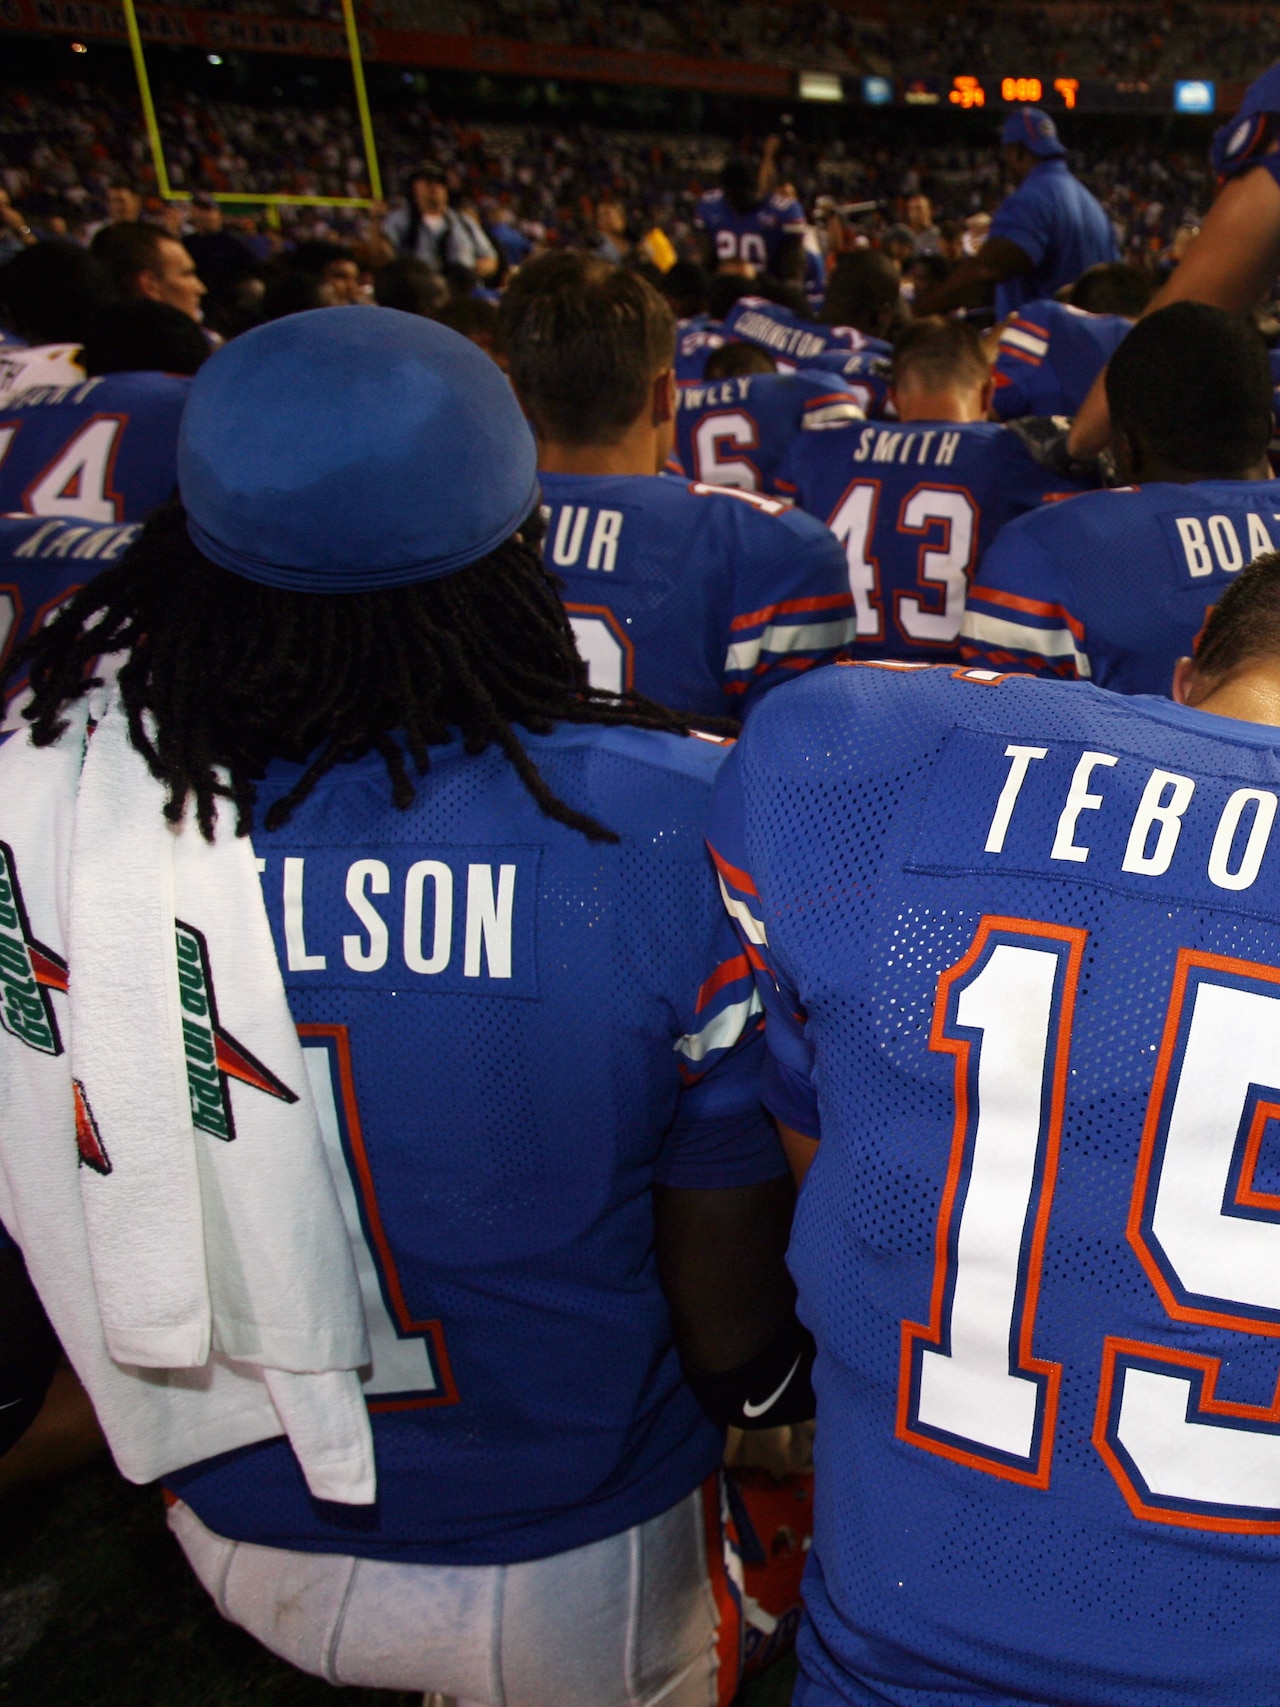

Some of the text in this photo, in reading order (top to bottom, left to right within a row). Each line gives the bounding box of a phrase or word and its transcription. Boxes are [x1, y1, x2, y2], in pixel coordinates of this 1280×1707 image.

[853, 427, 961, 466] SMITH
[540, 504, 624, 573] UR
[829, 477, 981, 648] 43
